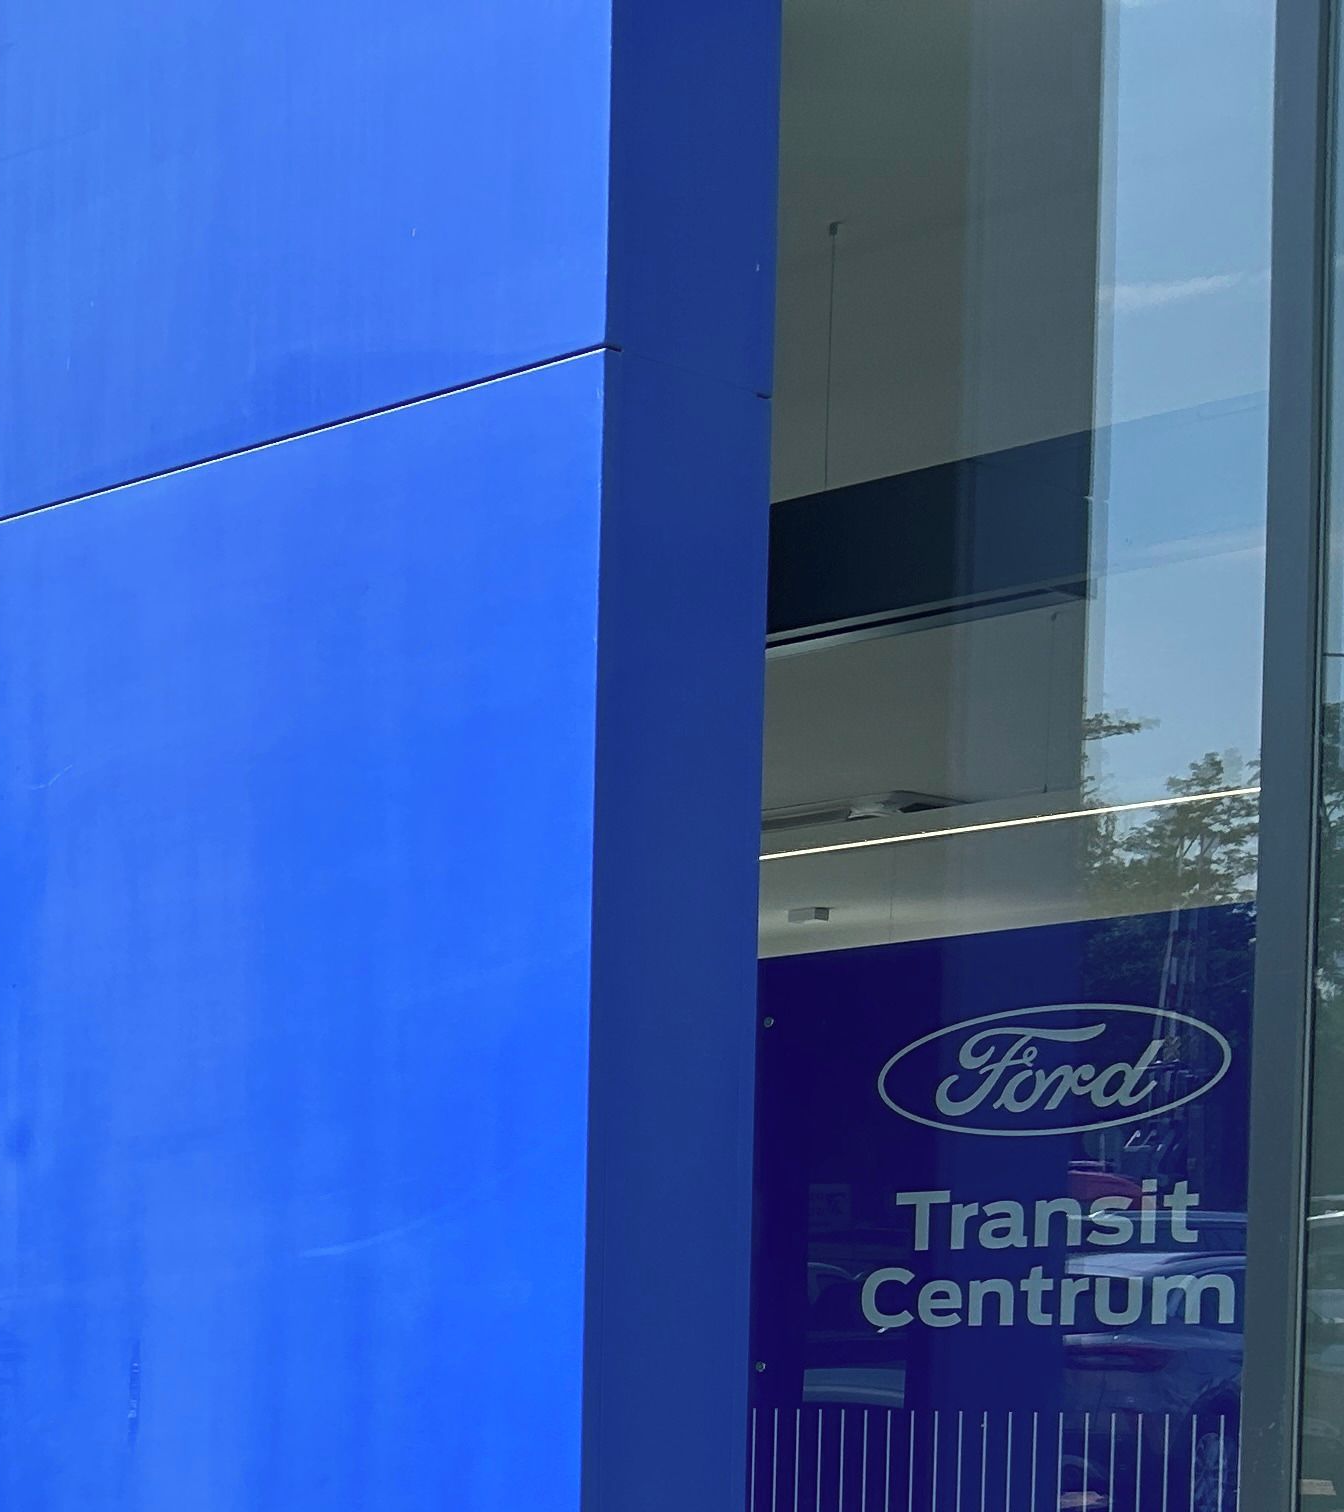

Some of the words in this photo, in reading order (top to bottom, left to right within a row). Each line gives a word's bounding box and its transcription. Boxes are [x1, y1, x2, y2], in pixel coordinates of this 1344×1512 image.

[935, 1023, 1164, 1116] Ford
[896, 1178, 1200, 1251] Transit
[861, 1266, 1235, 1328] Centrum
